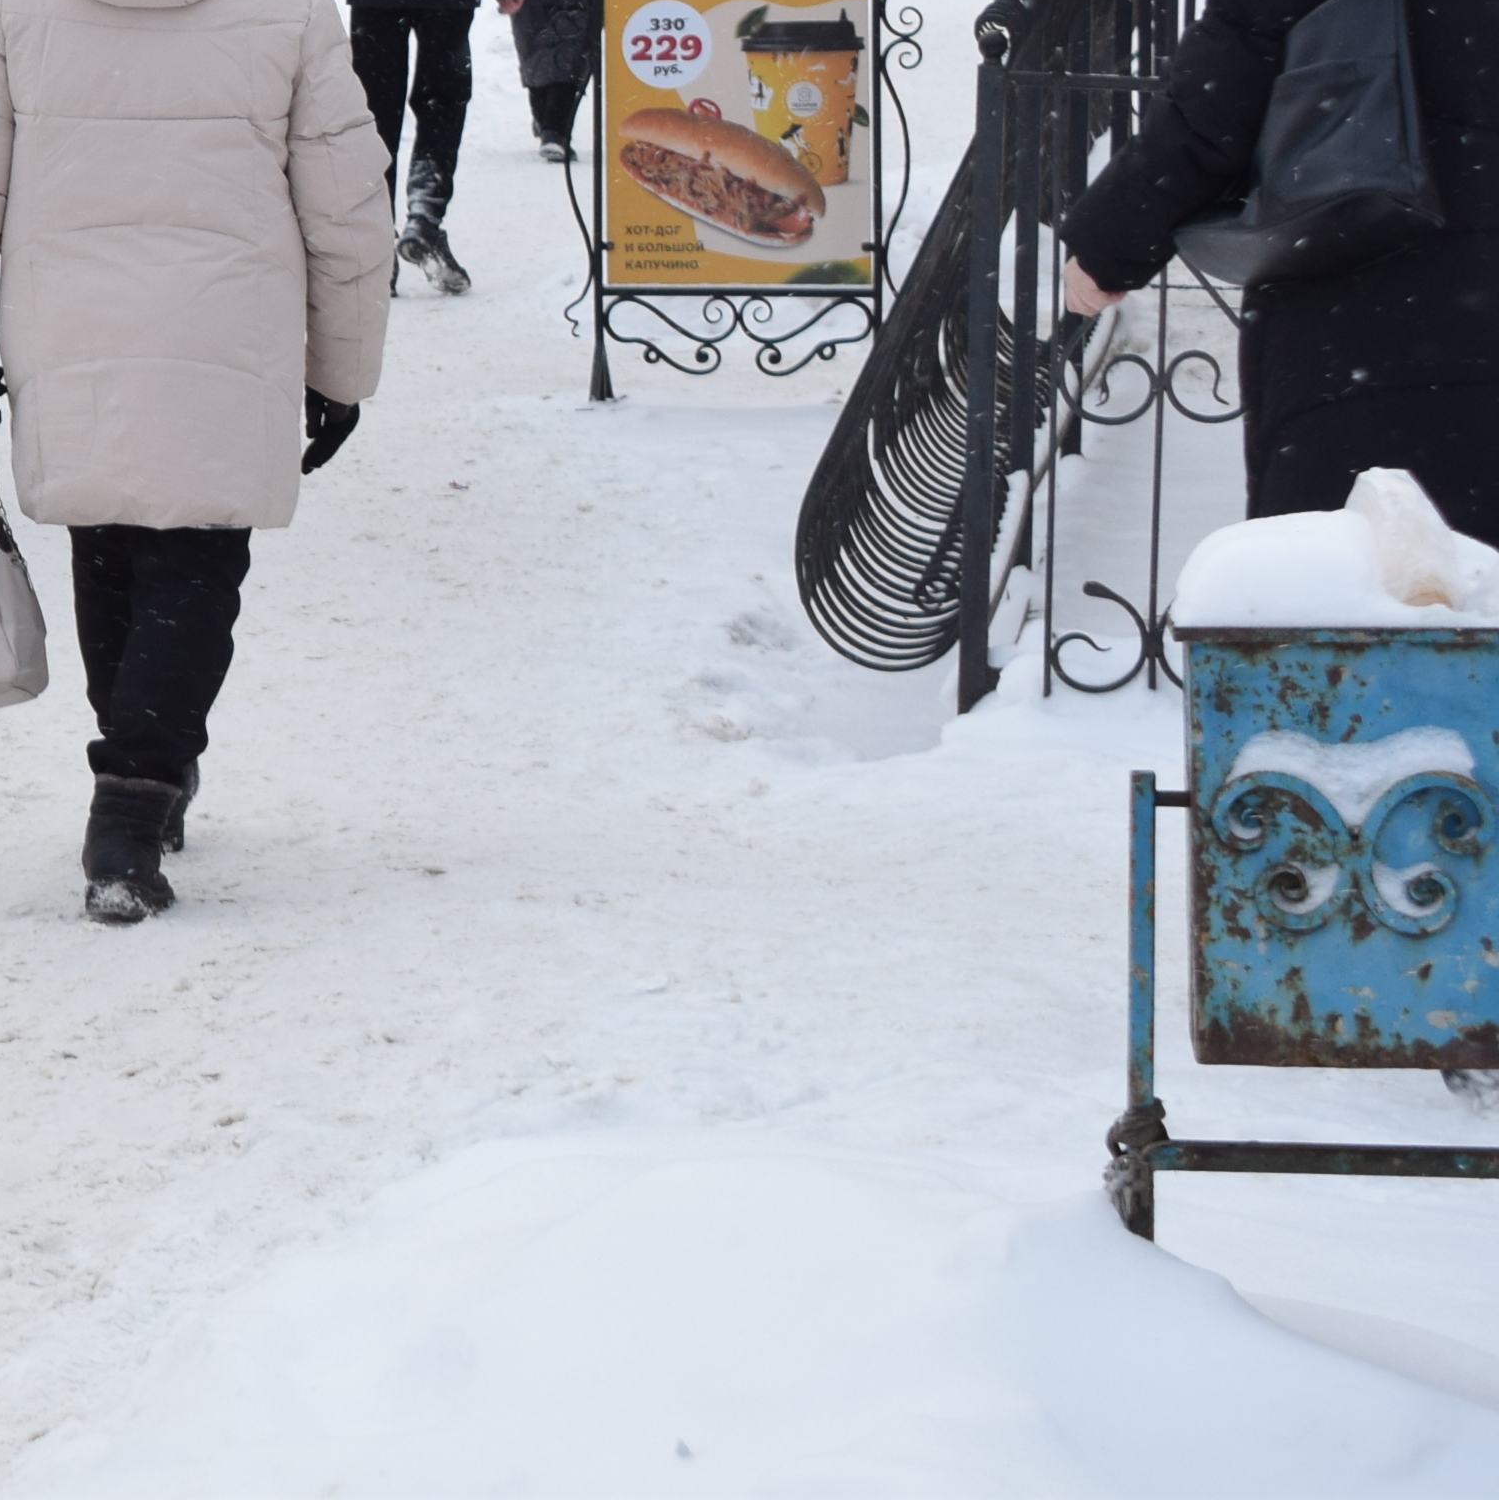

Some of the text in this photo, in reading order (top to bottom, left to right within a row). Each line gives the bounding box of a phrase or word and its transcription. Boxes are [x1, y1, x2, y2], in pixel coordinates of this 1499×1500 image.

[649, 18, 685, 32] 330
[631, 34, 702, 61] 229
[653, 64, 683, 76] руб.
[625, 225, 682, 237] ХОТ-ДОГ
[625, 239, 705, 252] И БОЛЬШОЙ
[625, 259, 700, 270] КАПУЧИНО
